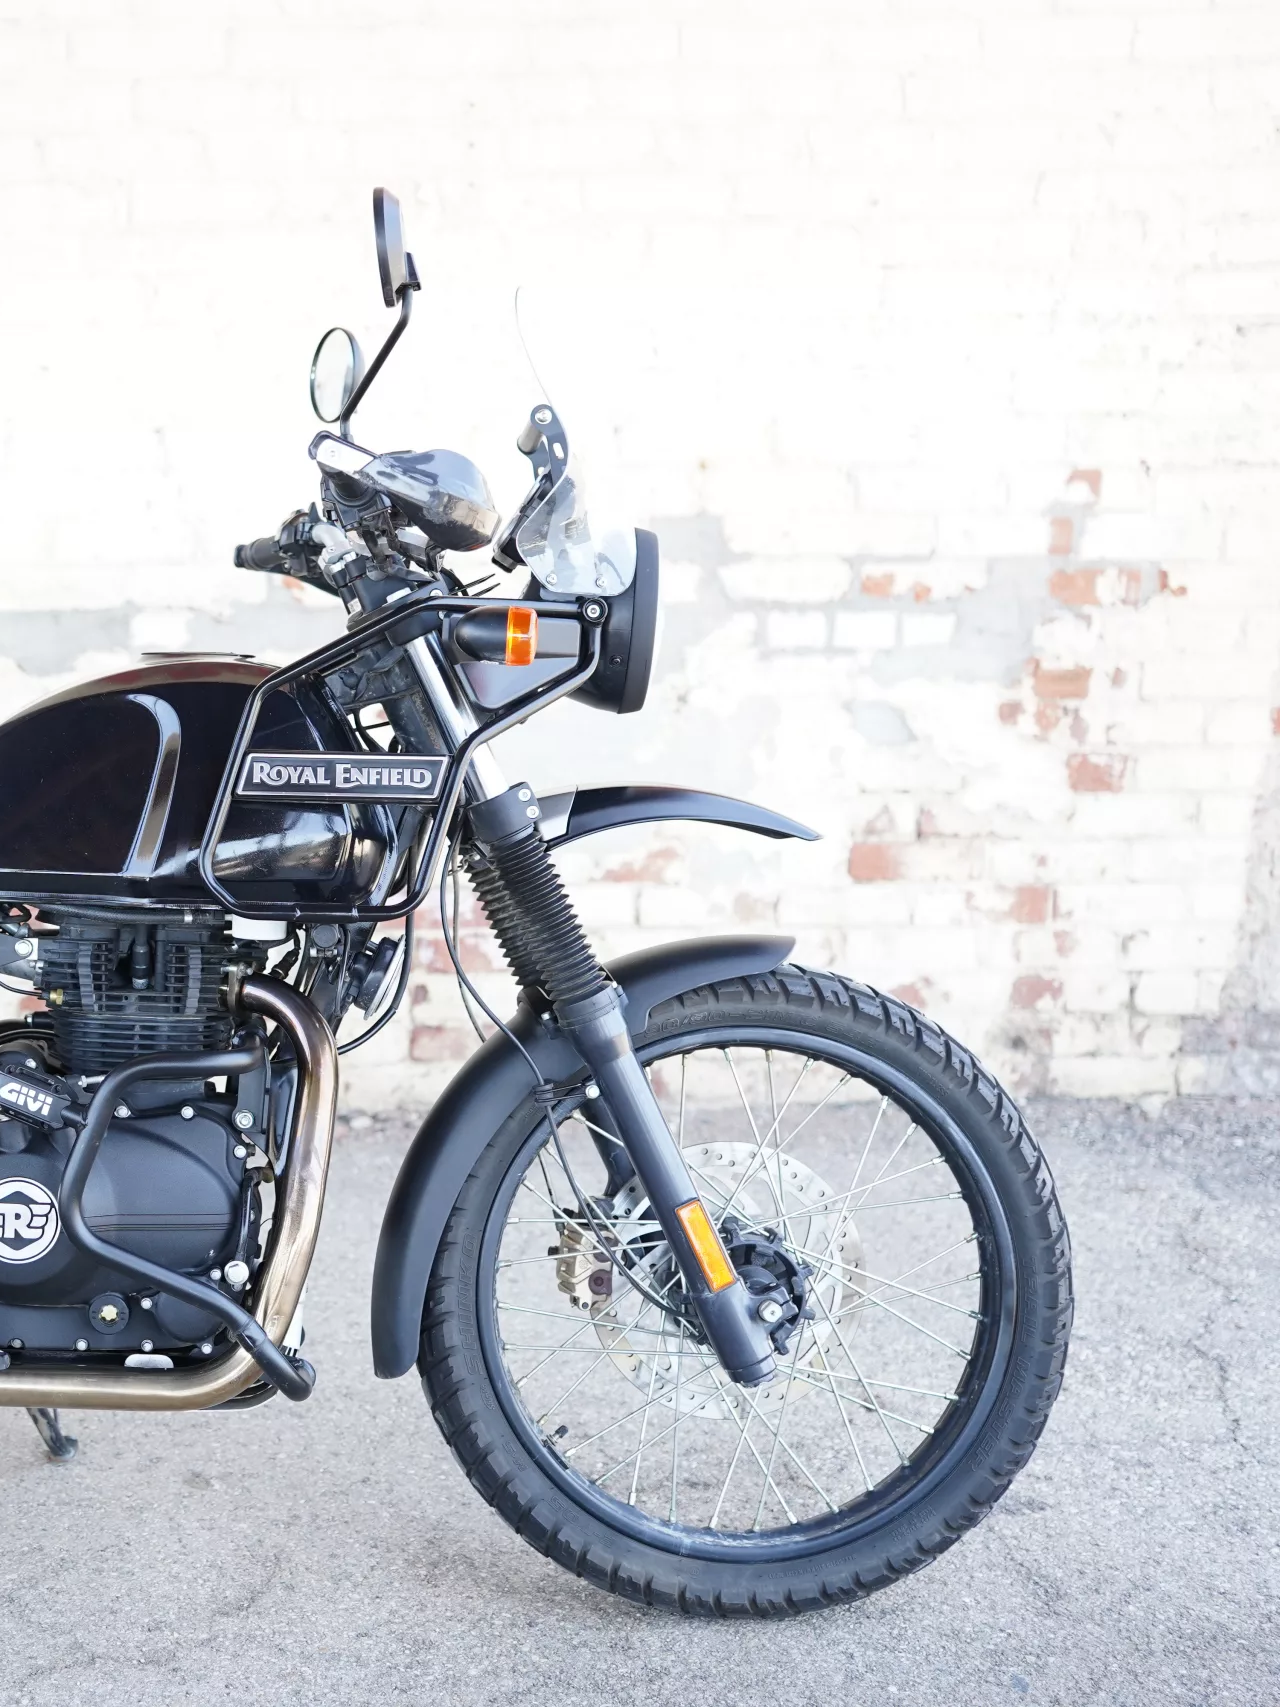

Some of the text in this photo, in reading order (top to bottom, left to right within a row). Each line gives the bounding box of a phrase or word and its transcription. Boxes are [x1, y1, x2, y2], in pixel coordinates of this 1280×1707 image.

[252, 762, 432, 789] ROYAL ENFIELD
[0, 1082, 54, 1117] GIVI
[456, 1231, 484, 1379] SHINKO
[1020, 1255, 1038, 1344] TRAIL
